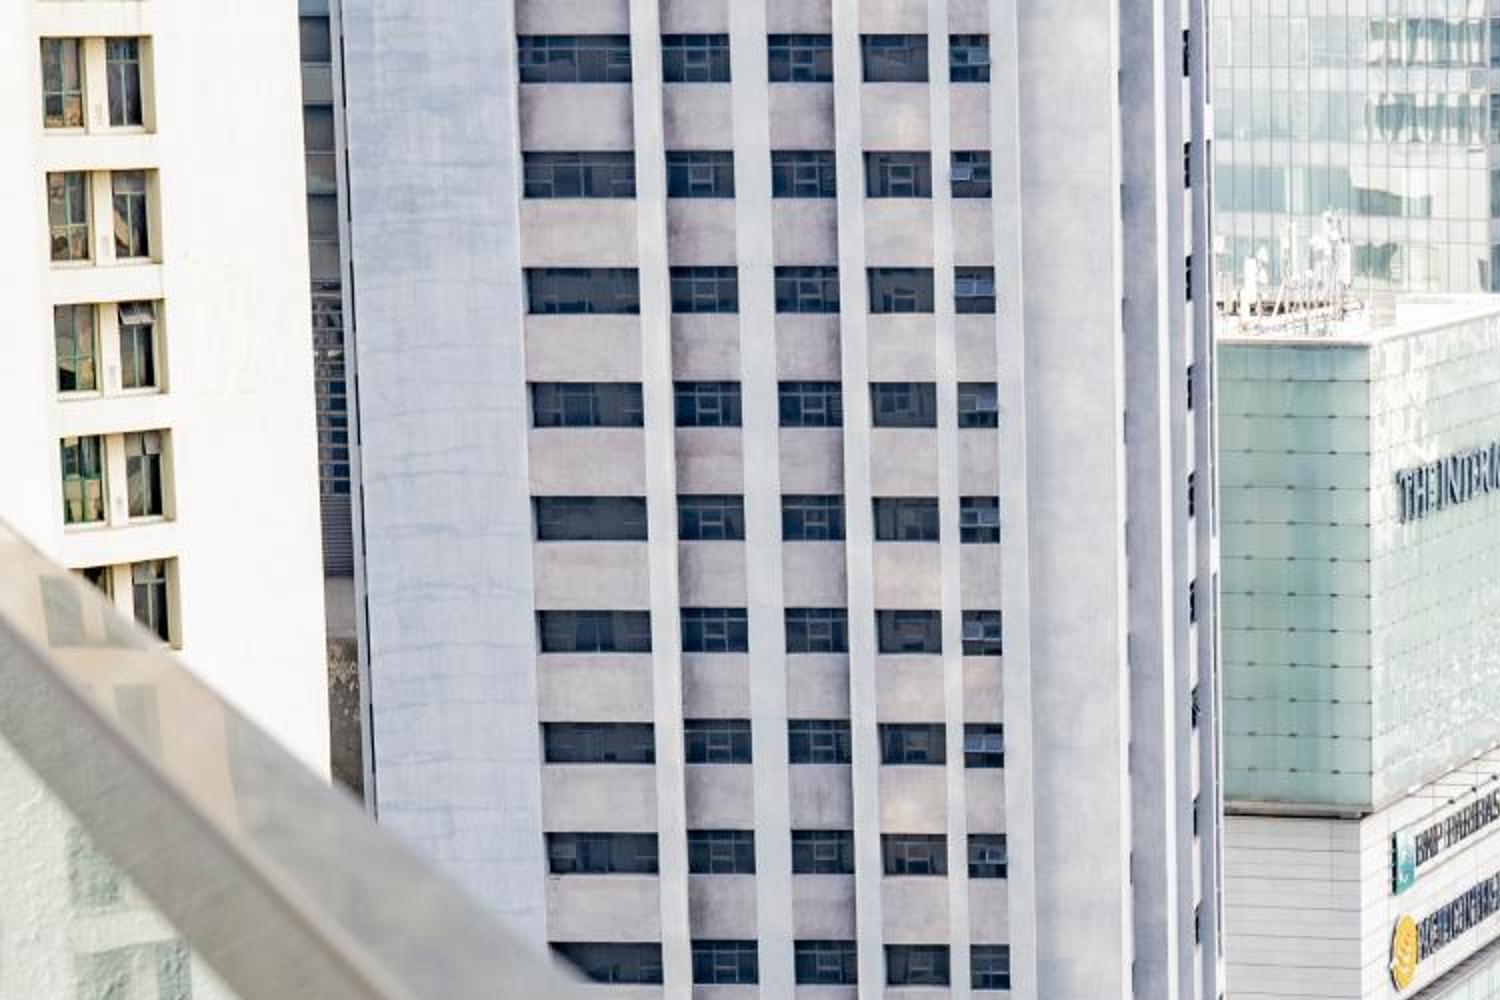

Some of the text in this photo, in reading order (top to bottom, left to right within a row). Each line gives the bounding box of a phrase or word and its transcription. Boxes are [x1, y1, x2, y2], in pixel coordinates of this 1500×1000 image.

[1395, 464, 1439, 524] THE
[1414, 822, 1443, 867] BNP
[1444, 788, 1500, 849] PARIBAS
